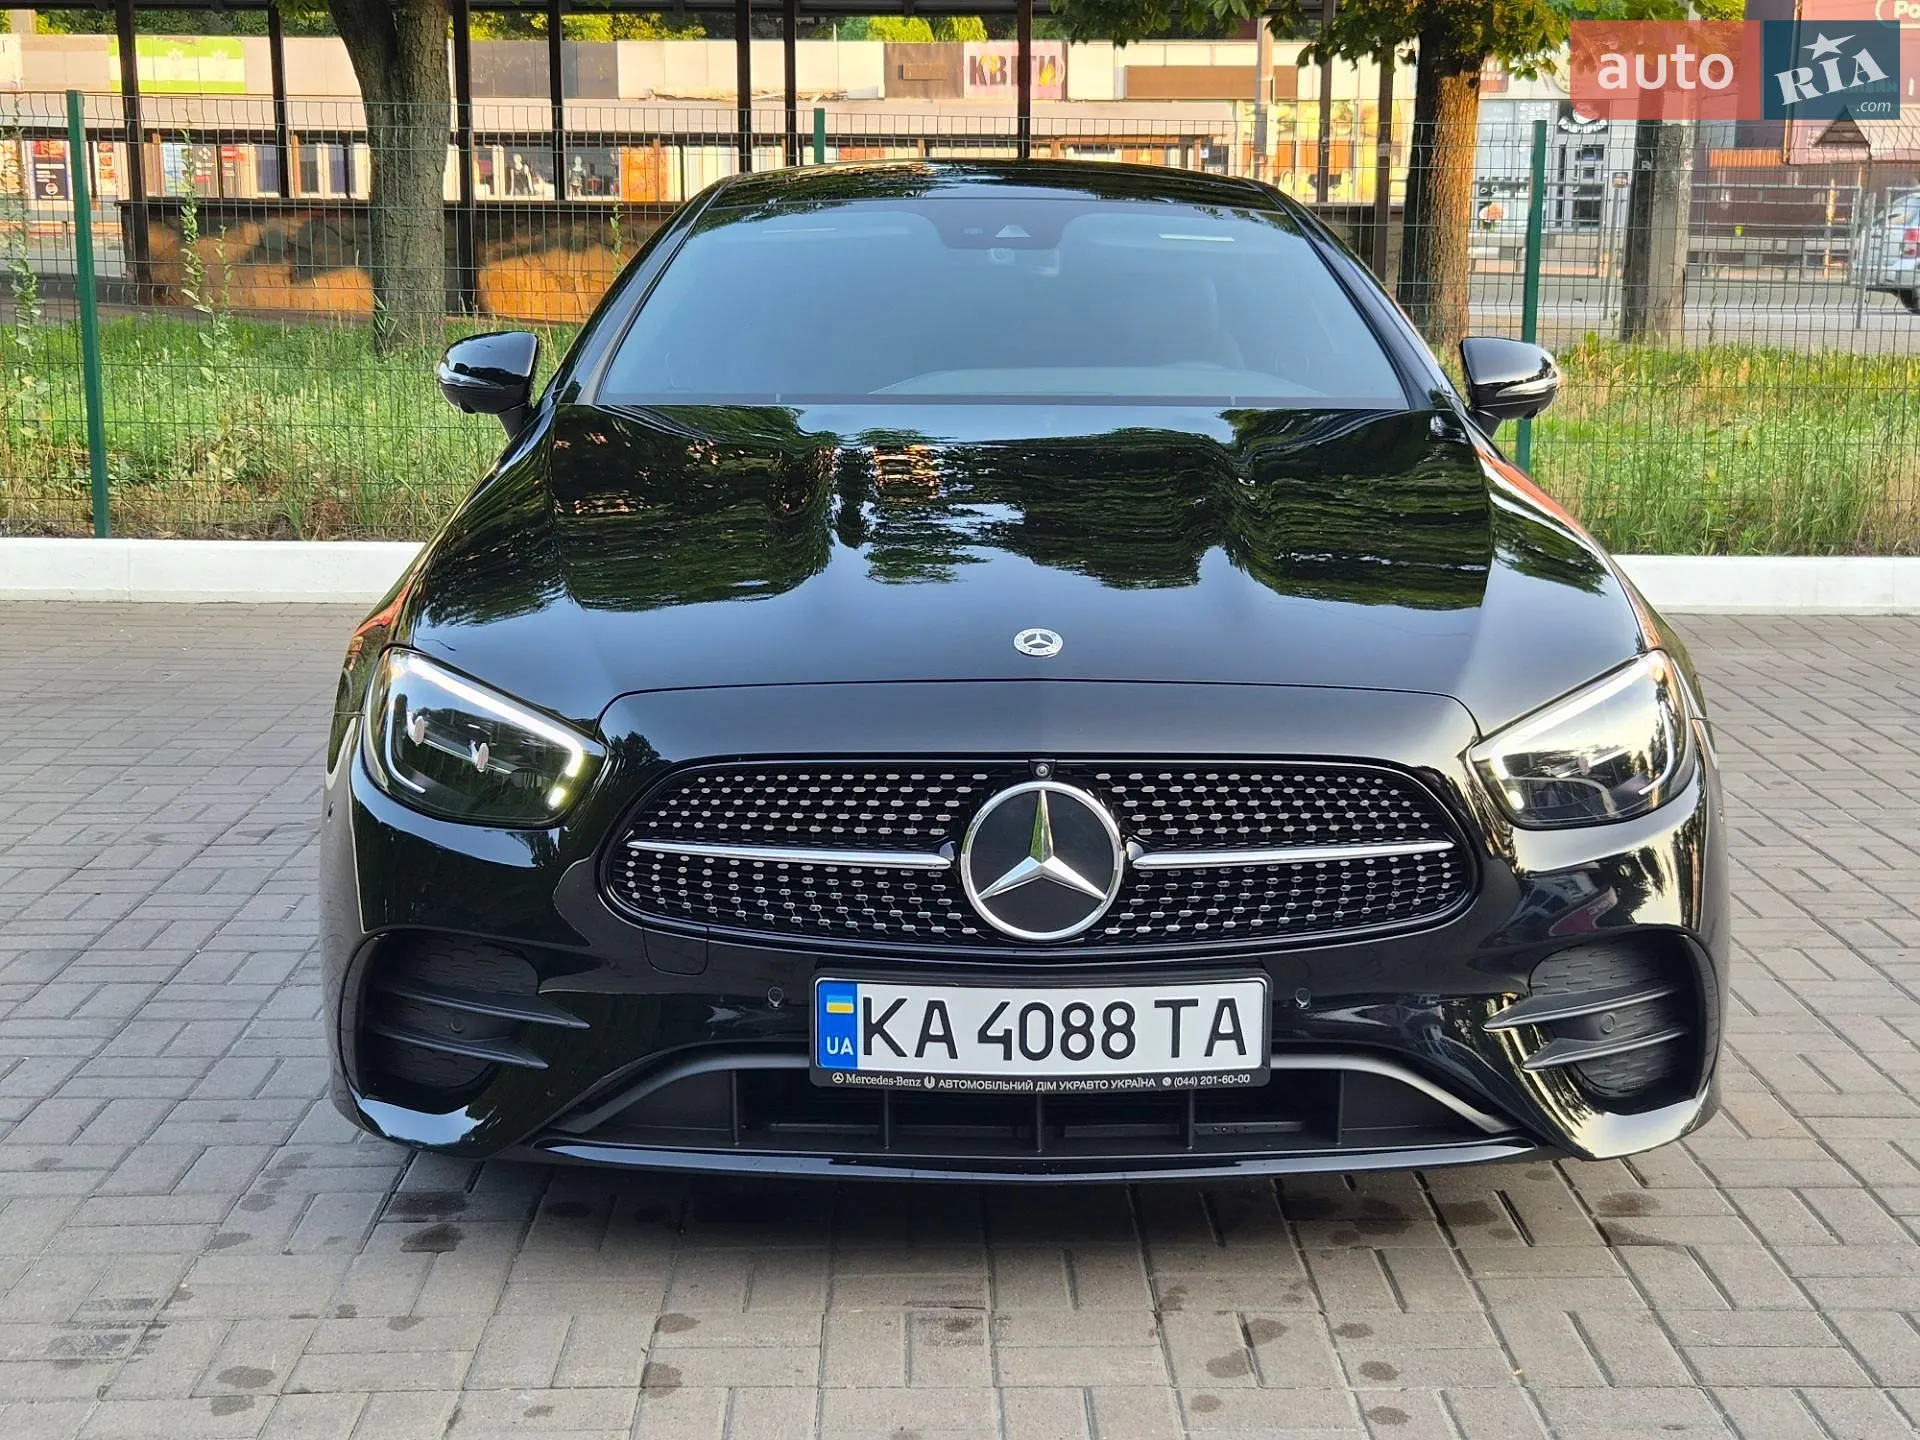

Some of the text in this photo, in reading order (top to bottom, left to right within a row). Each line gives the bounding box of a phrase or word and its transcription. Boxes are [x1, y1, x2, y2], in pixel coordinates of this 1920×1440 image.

[969, 55, 1056, 86] КВІИ
[862, 996, 1248, 1062] KA 4088 TA
[827, 1036, 854, 1055] UA
[846, 1074, 922, 1087] Mercedes-Benz
[938, 1074, 1250, 1092] АВТОМОБІЛЬНИЙ ДІМ УКРАВТО УКРАЇНА (044) 201-60-00
